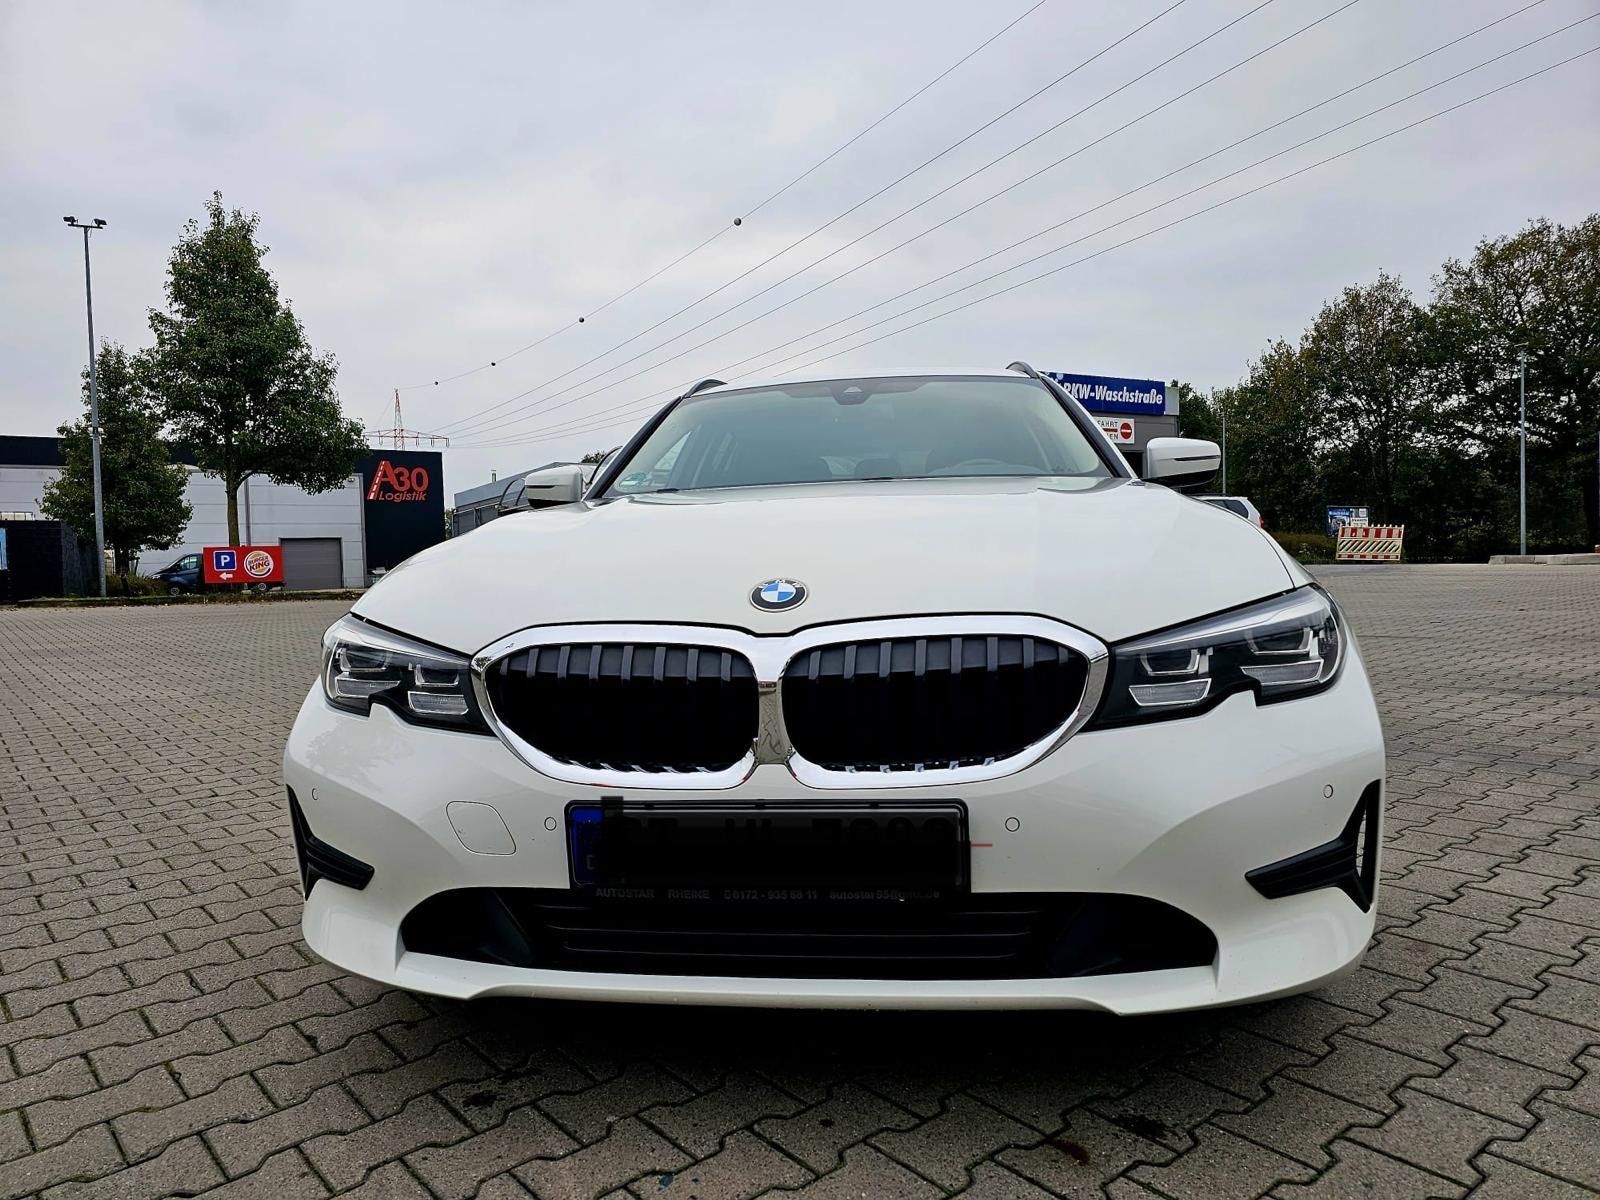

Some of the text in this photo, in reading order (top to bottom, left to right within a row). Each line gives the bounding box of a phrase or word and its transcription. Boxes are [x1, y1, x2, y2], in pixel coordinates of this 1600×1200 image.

[367, 460, 429, 500] A30
[379, 491, 426, 503] Logistik
[220, 555, 231, 567] P
[249, 560, 270, 571] KING
[595, 888, 655, 899] AUTOSTAR
